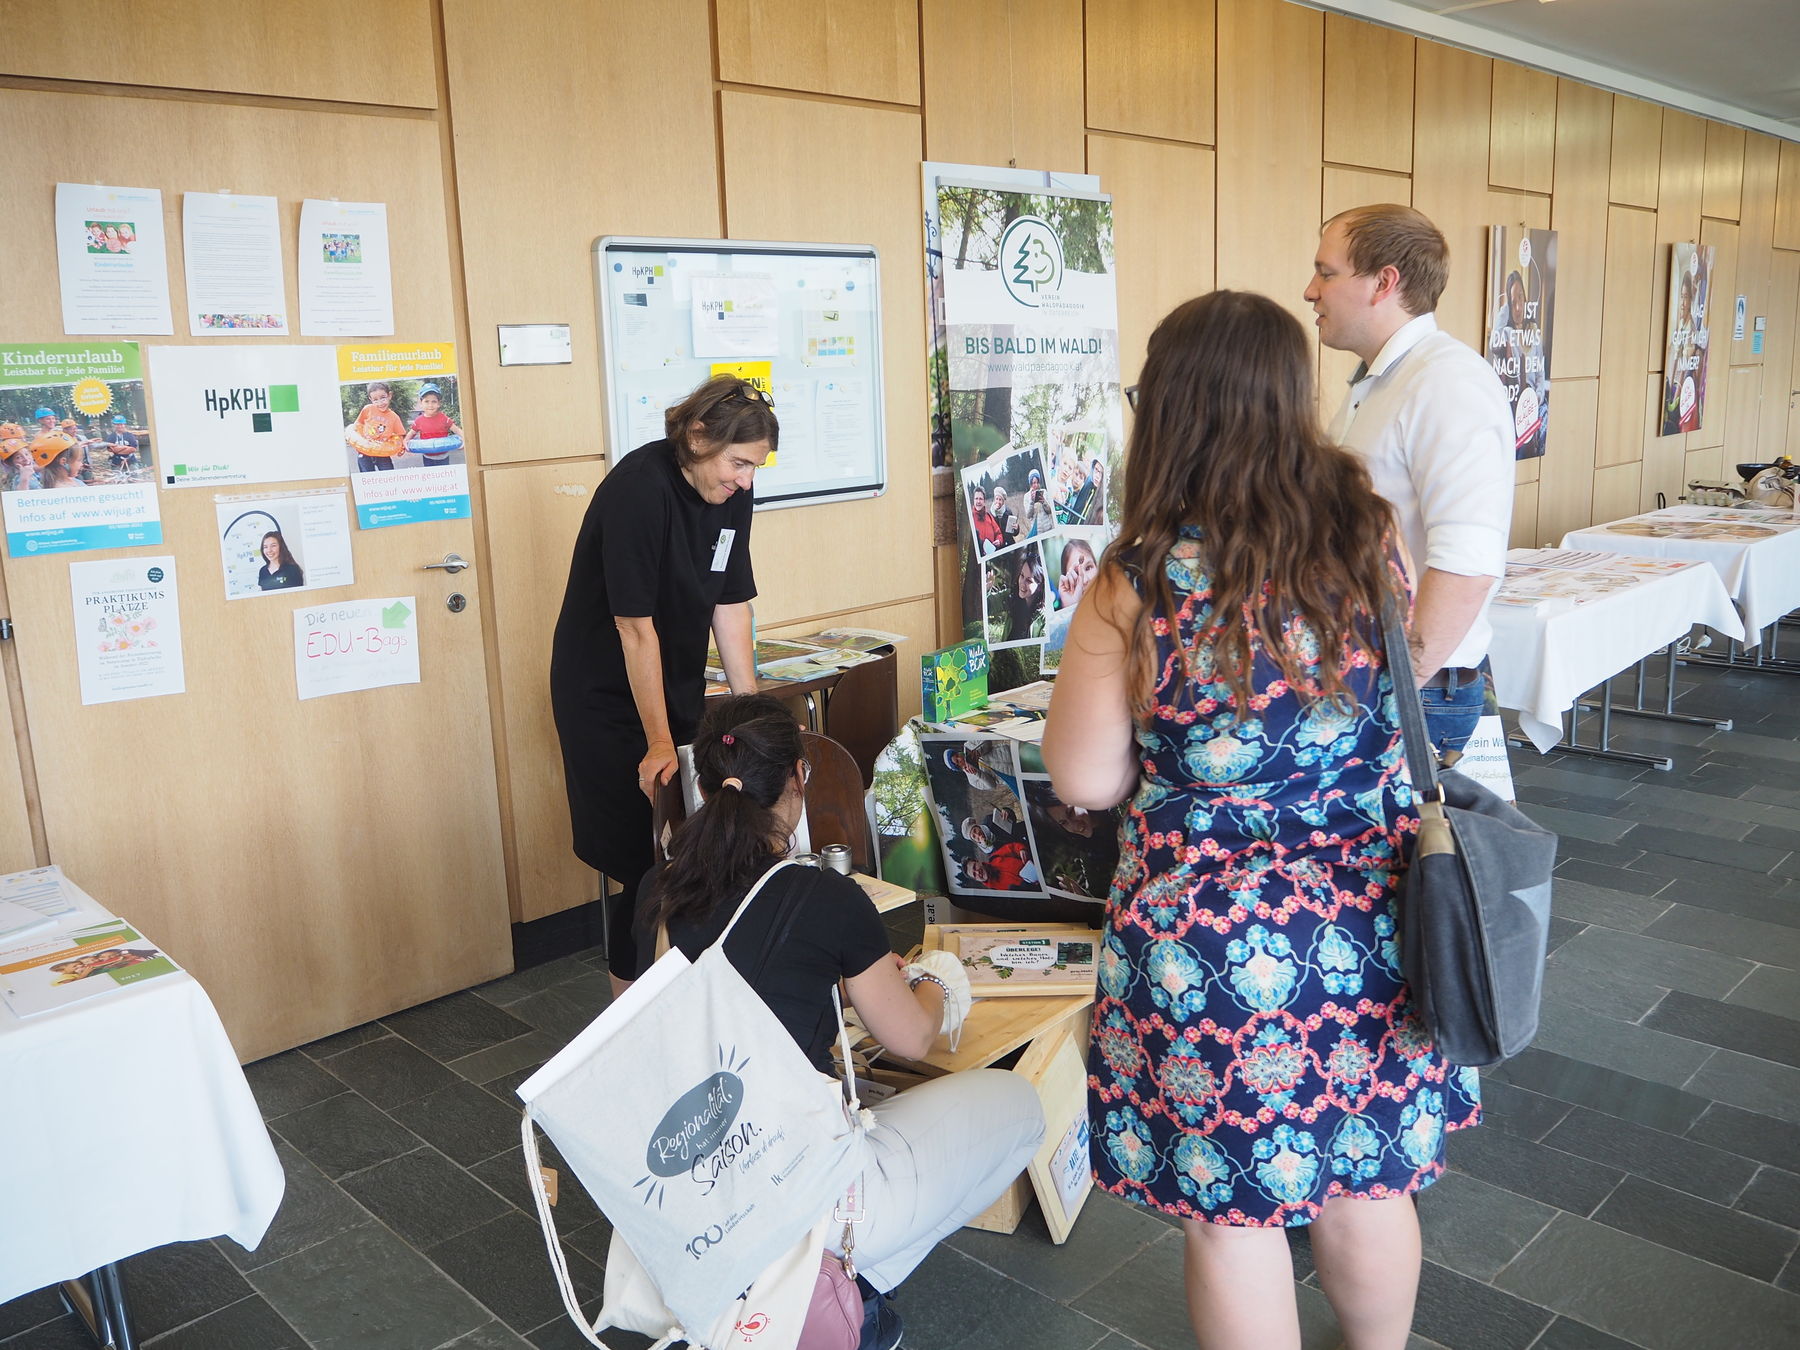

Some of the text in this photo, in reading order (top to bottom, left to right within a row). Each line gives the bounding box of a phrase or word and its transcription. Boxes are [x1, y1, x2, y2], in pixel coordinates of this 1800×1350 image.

[632, 266, 654, 278] HpKPH
[701, 300, 724, 313] HpKPH
[1523, 301, 1539, 320] IST
[965, 337, 1103, 355] BIS BALD IM WALD!
[1492, 328, 1542, 348] DA ETWAS
[2, 348, 124, 365] Kinderurlaub
[351, 348, 443, 362] Familienurlaub
[4, 365, 125, 377] Leistbar für jede Familie!
[1492, 356, 1545, 376] NACH DEM
[205, 387, 268, 420] HpKPH
[361, 469, 457, 486] BetreuerInnen gesucht!
[17, 489, 144, 508] BetreuerInnen gesucht!
[385, 487, 398, 497] auf
[401, 482, 459, 495] www.wijug.at
[19, 505, 145, 523] Infos auf www.wijug.at
[85, 590, 166, 606] PRAKTIKUMS
[103, 601, 150, 614] PLÄTZE
[304, 611, 328, 626] Die
[306, 627, 408, 659] EDU-Bags
[968, 645, 985, 658] Wald
[968, 654, 987, 673] BOX
[696, 1118, 728, 1151] hat immer
[691, 1121, 763, 1196] Saison.
[685, 1224, 724, 1260] 100
